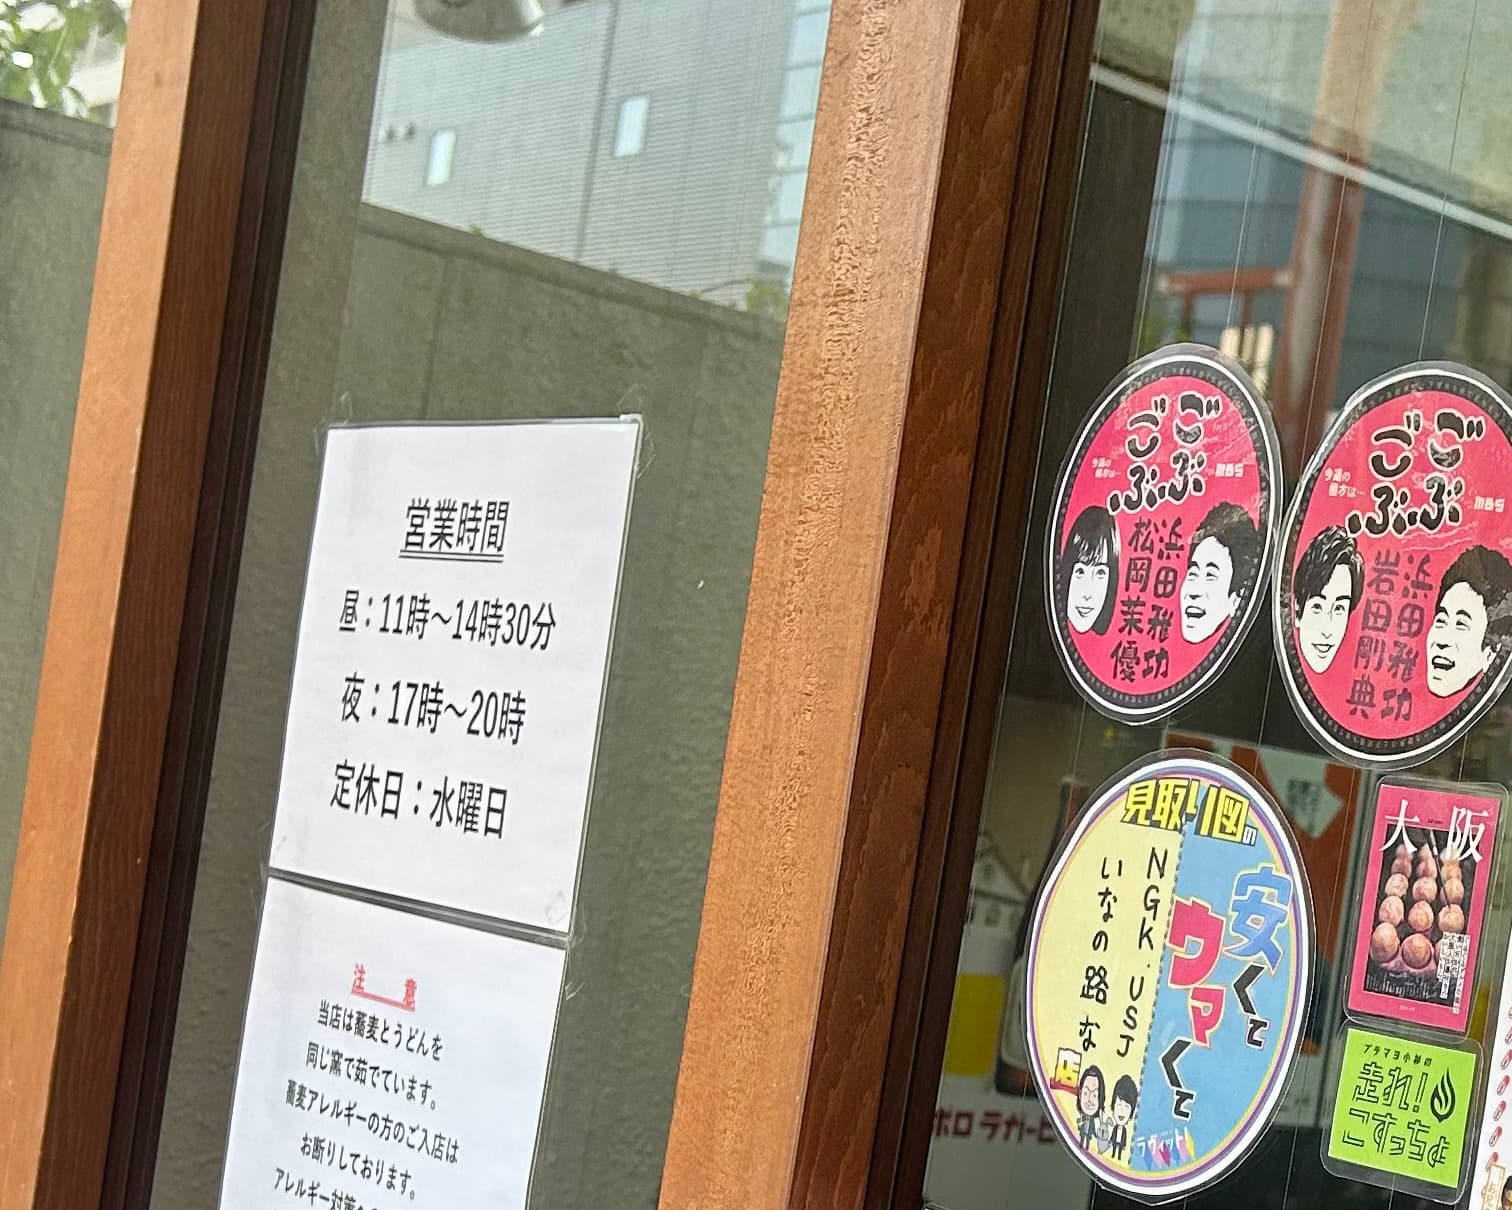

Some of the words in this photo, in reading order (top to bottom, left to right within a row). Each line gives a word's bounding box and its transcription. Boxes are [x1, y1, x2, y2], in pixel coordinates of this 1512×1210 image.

[404, 498, 510, 553] 営業時間
[1346, 549, 1400, 720] 岩田剛典
[1379, 799, 1488, 863] 大阪
[352, 964, 417, 1007] 注意
[1223, 864, 1292, 1048] 安くて
[317, 999, 443, 1062] 当店は蕎麦とうどんを
[1161, 898, 1226, 1120] ウマくて
[305, 1041, 436, 1110] 同じ窯で茹でています。
[285, 1079, 460, 1164] 蕎麦アレルギーの方のご入店は
[300, 1132, 416, 1199] お断りしております。
